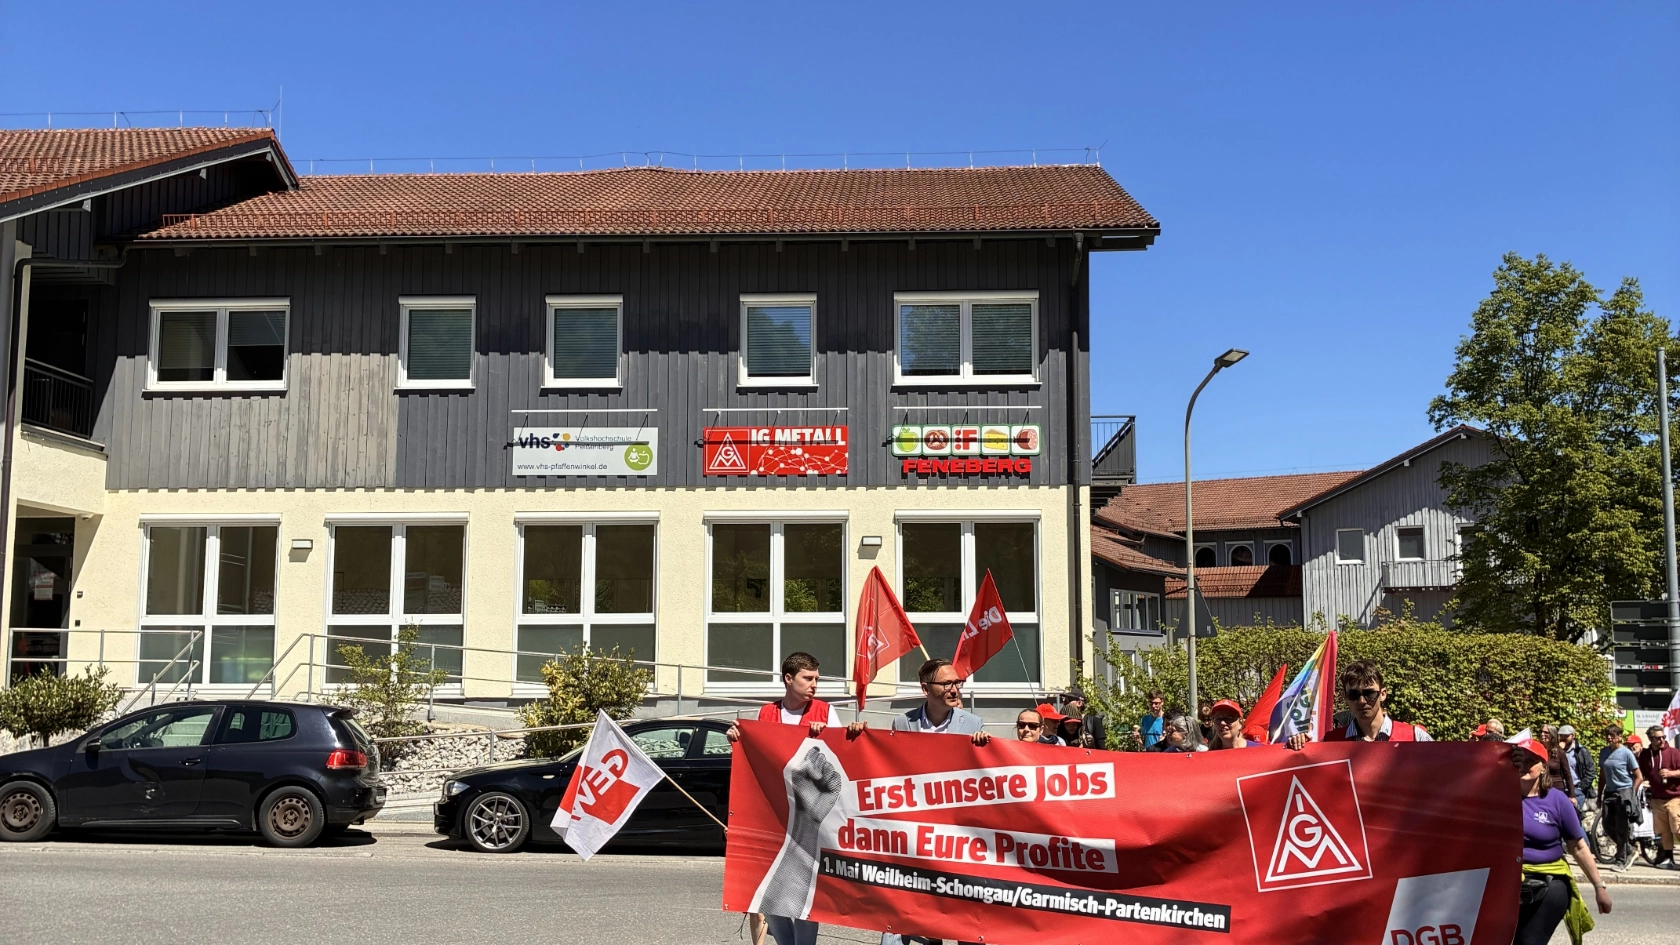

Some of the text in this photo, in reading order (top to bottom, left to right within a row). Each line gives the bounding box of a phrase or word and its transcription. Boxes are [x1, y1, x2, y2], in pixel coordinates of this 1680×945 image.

[519, 433, 551, 449] vhs
[751, 428, 846, 447] IG METALL
[517, 463, 608, 471] www.vhs-pfaffenwinkel.de
[903, 458, 1032, 473] FENEBERG
[856, 764, 1108, 812] Erst unsere Jobs
[838, 817, 1106, 871] dann Eure Profite
[823, 856, 1226, 929] 1. Mai Weilheim-Schongau/Garmisch-Partenkirchen
[1390, 923, 1465, 945] DGB
